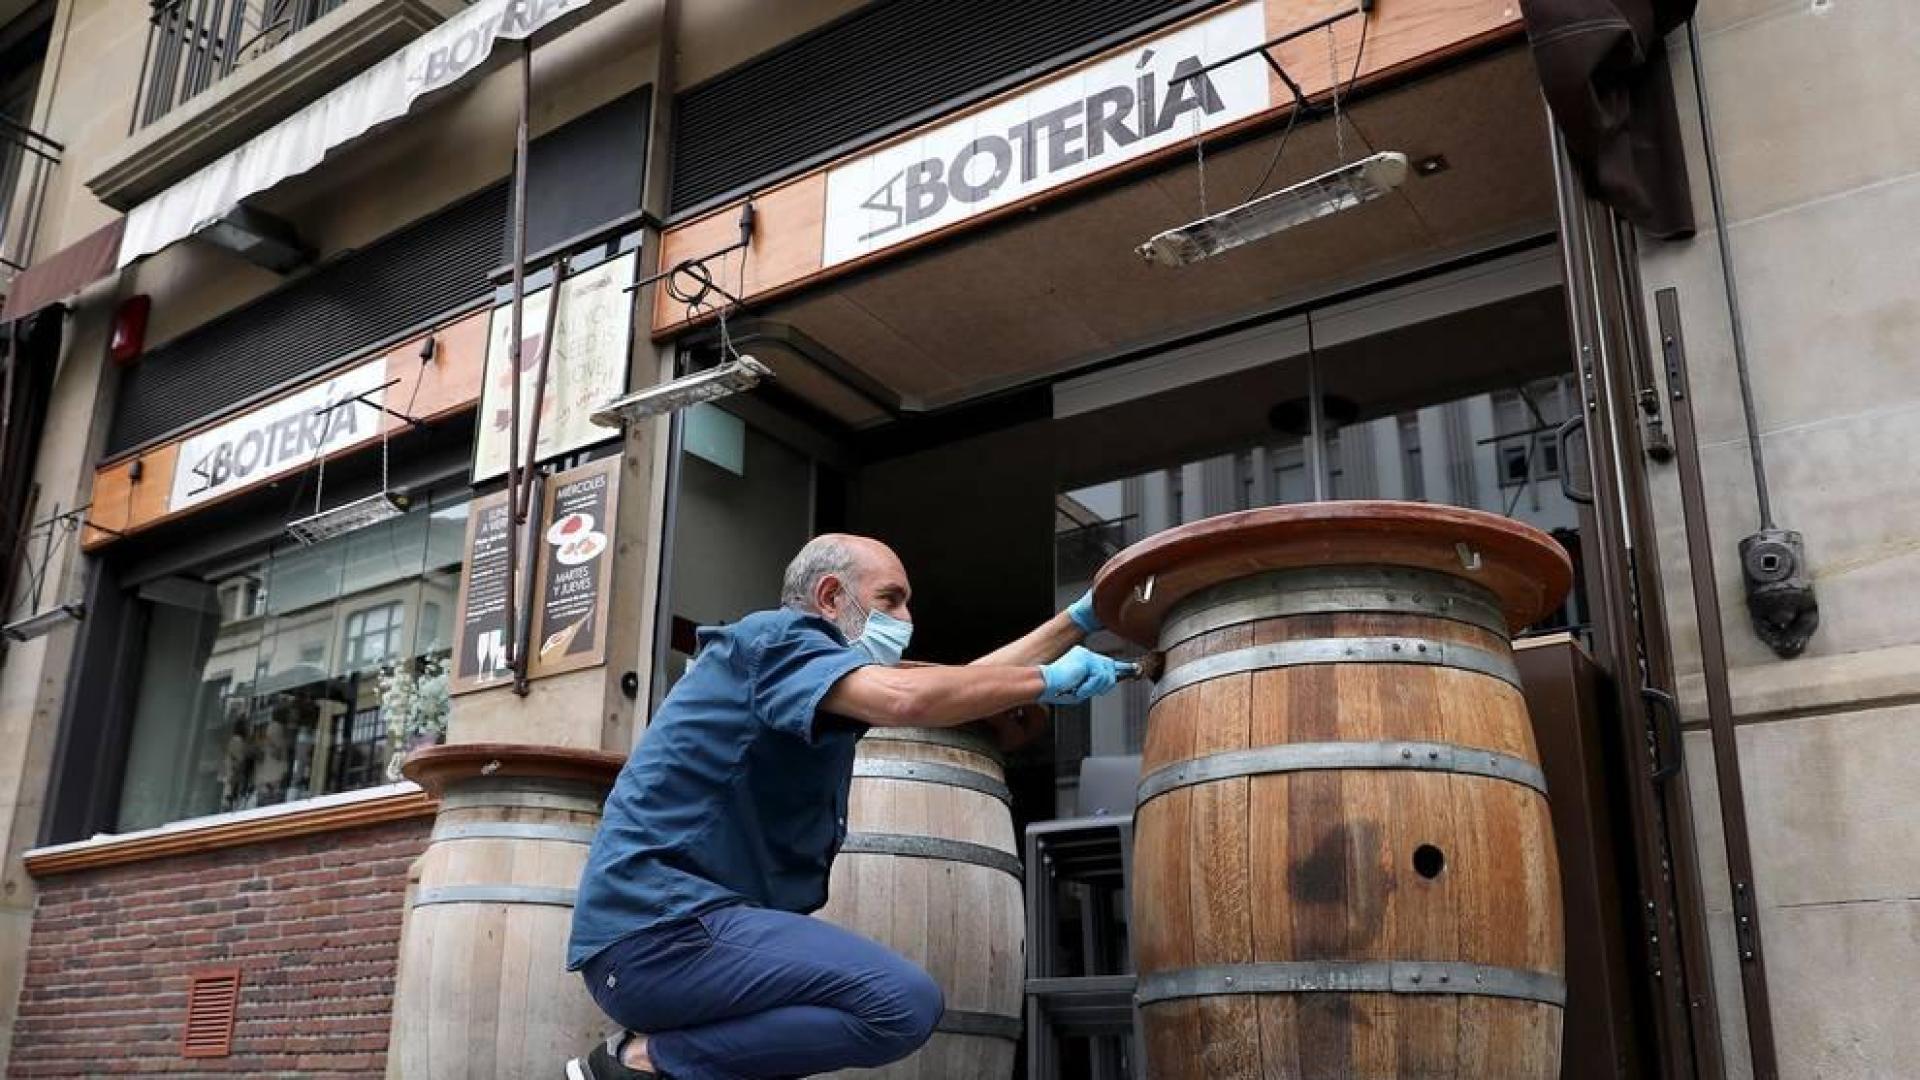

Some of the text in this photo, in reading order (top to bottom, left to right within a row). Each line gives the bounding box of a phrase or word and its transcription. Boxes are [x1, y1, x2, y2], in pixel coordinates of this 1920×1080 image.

[858, 49, 1226, 242] LA BOTERÍA
[209, 381, 358, 488] BOTERÍA
[555, 566, 589, 584] MARTES
